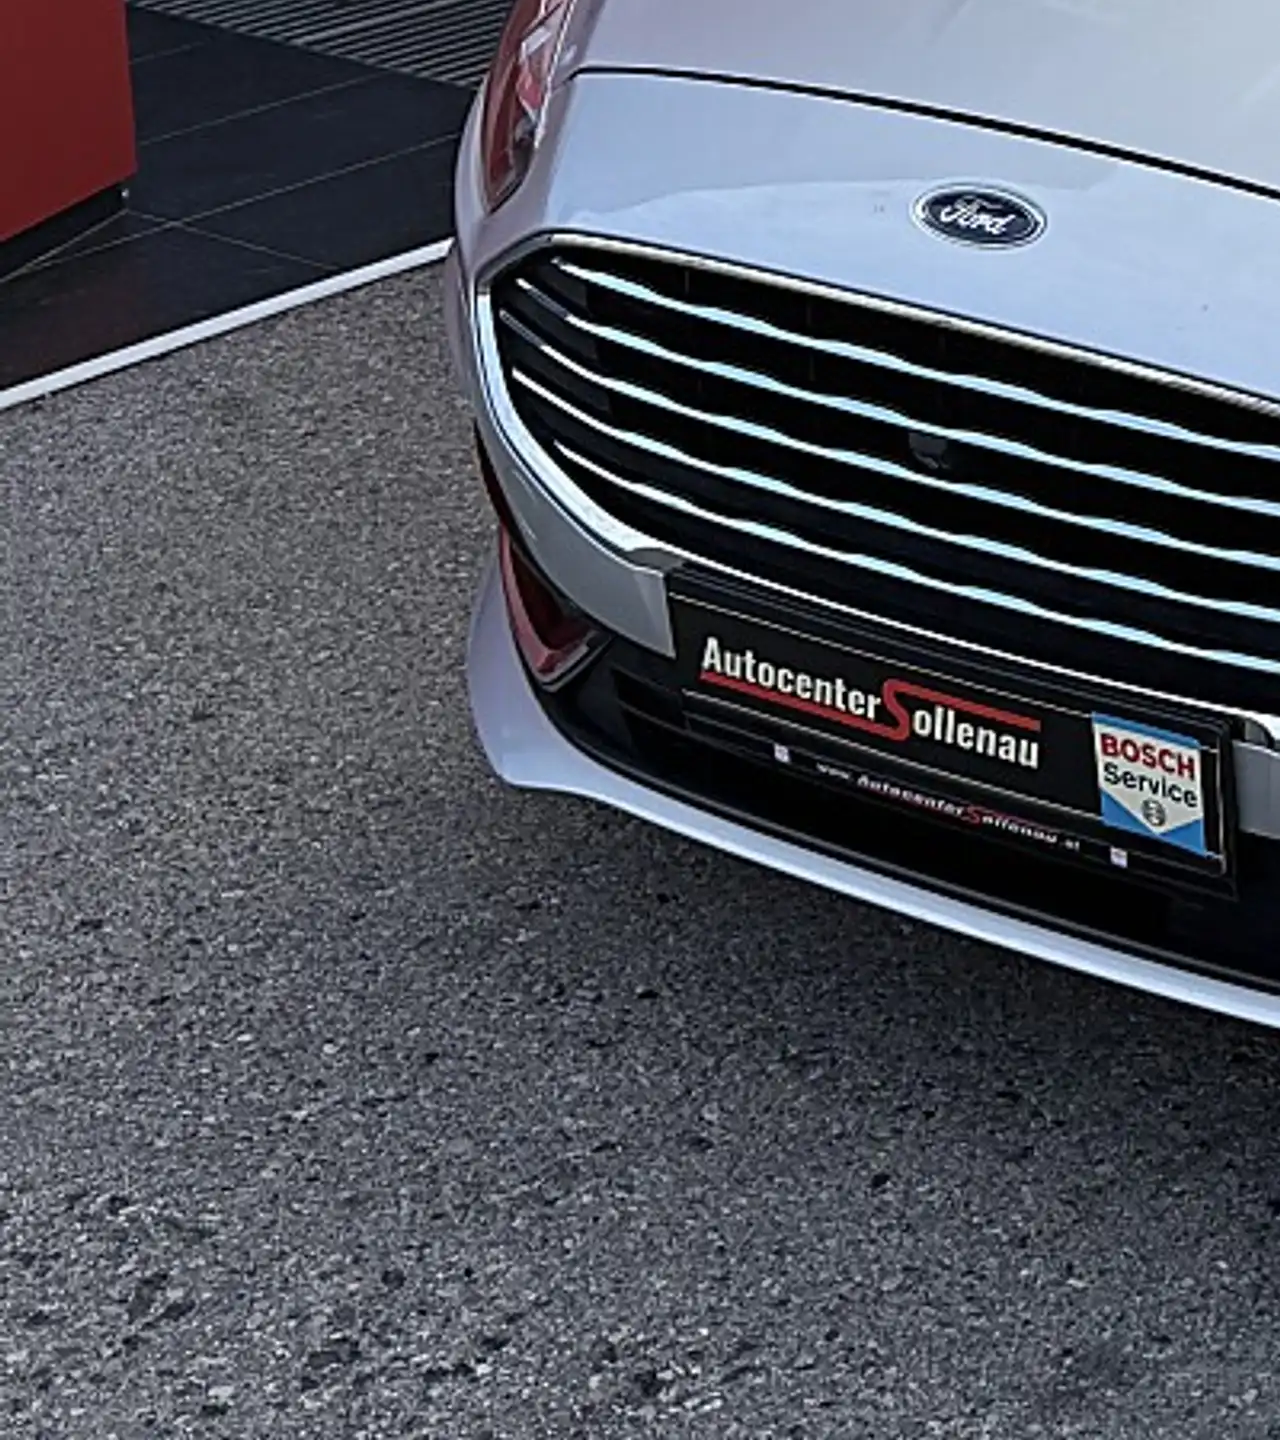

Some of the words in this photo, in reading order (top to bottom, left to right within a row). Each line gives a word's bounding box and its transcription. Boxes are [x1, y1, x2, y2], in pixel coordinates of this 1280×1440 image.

[939, 195, 1016, 236] Ford
[1099, 731, 1197, 783] BOSCH
[1102, 762, 1199, 810] Service
